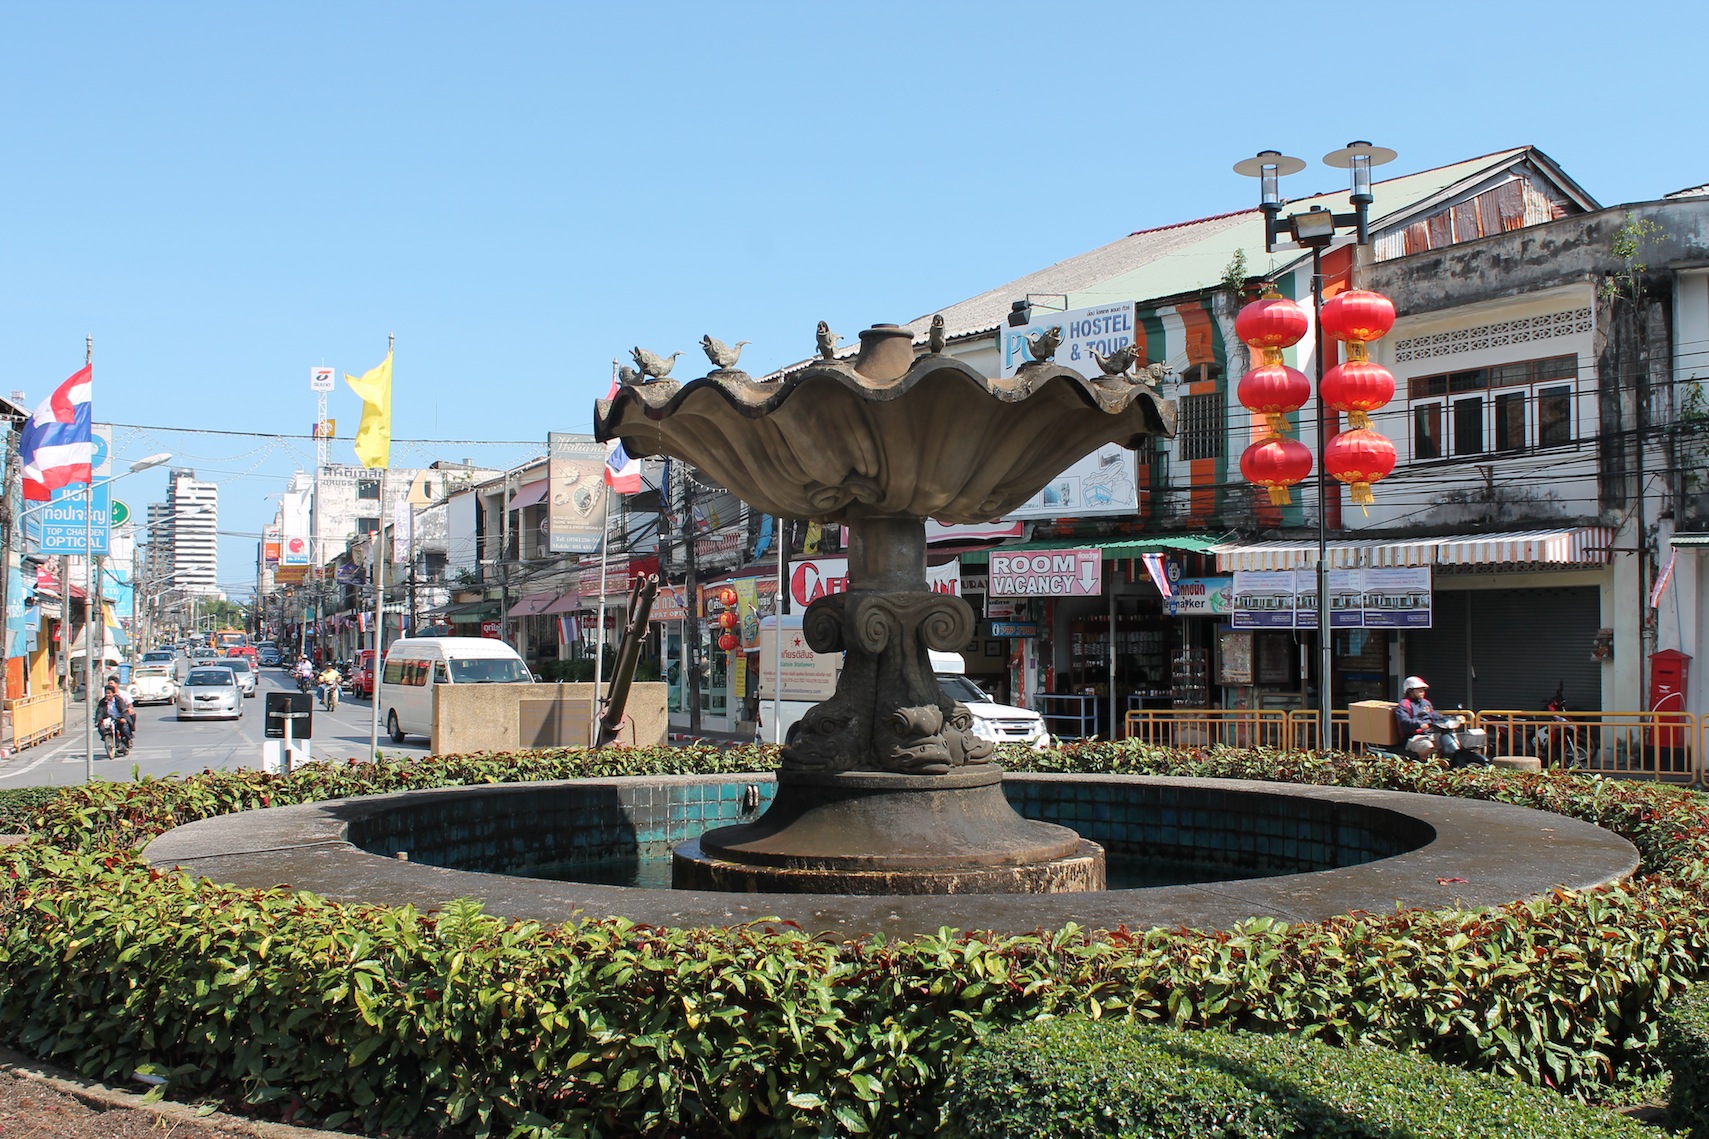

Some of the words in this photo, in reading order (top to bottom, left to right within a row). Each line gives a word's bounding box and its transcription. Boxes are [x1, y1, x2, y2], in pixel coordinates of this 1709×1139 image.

[1070, 314, 1131, 339] HOSTEL
[1070, 343, 1081, 361] &
[46, 527, 63, 535] TOP
[45, 536, 104, 548] OPTICAL
[992, 555, 1076, 574] ROOM
[993, 575, 1076, 594] VACANCY
